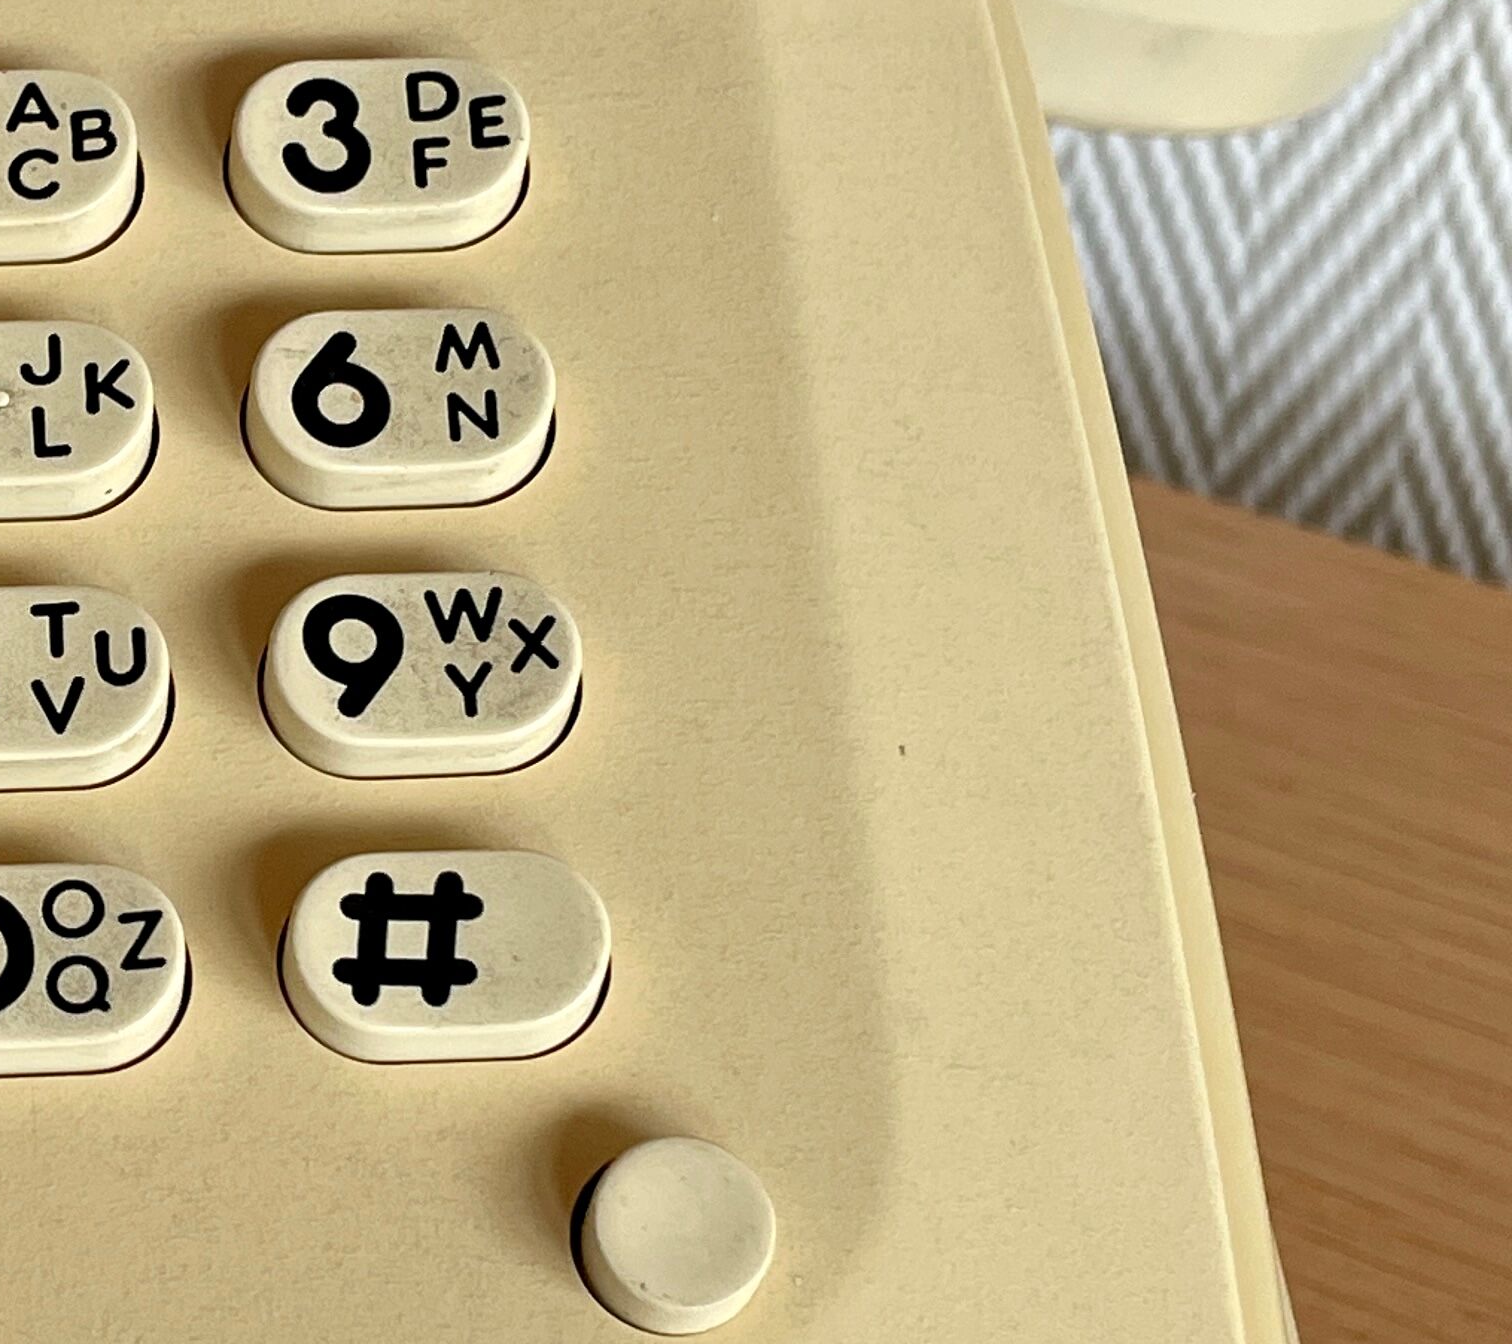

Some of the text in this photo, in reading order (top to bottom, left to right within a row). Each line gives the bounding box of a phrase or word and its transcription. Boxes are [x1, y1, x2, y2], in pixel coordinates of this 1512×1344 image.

[281, 77, 372, 194] 3
[291, 331, 392, 449] 6
[302, 594, 405, 719] 9
